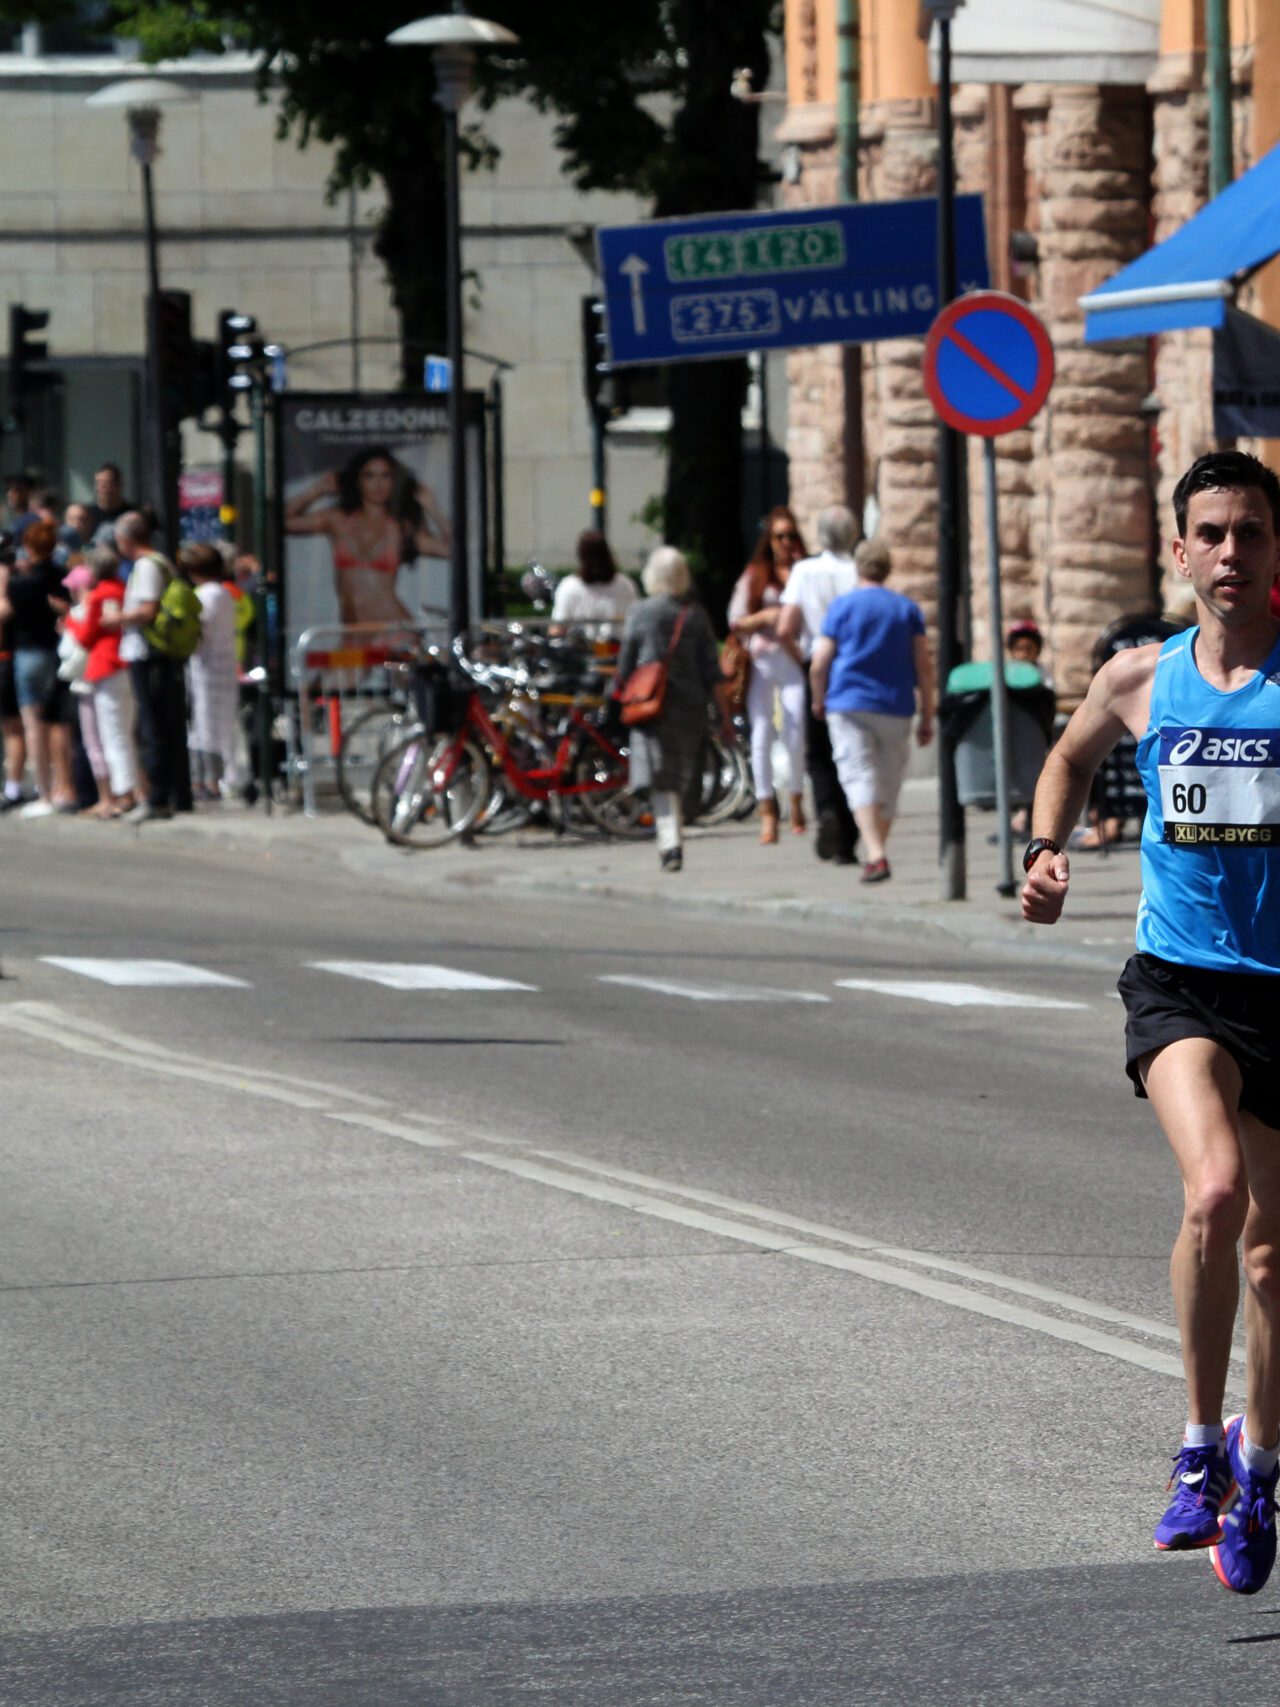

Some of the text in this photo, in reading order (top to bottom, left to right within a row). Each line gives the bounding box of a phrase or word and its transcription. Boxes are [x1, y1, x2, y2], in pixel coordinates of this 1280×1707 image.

[681, 233, 823, 272] E4 E20
[693, 277, 978, 332] 275 VÄLLING
[295, 408, 450, 432] CALZEDONI
[1172, 783, 1207, 815] 60
[1198, 827, 1273, 842] XL-BYGG
